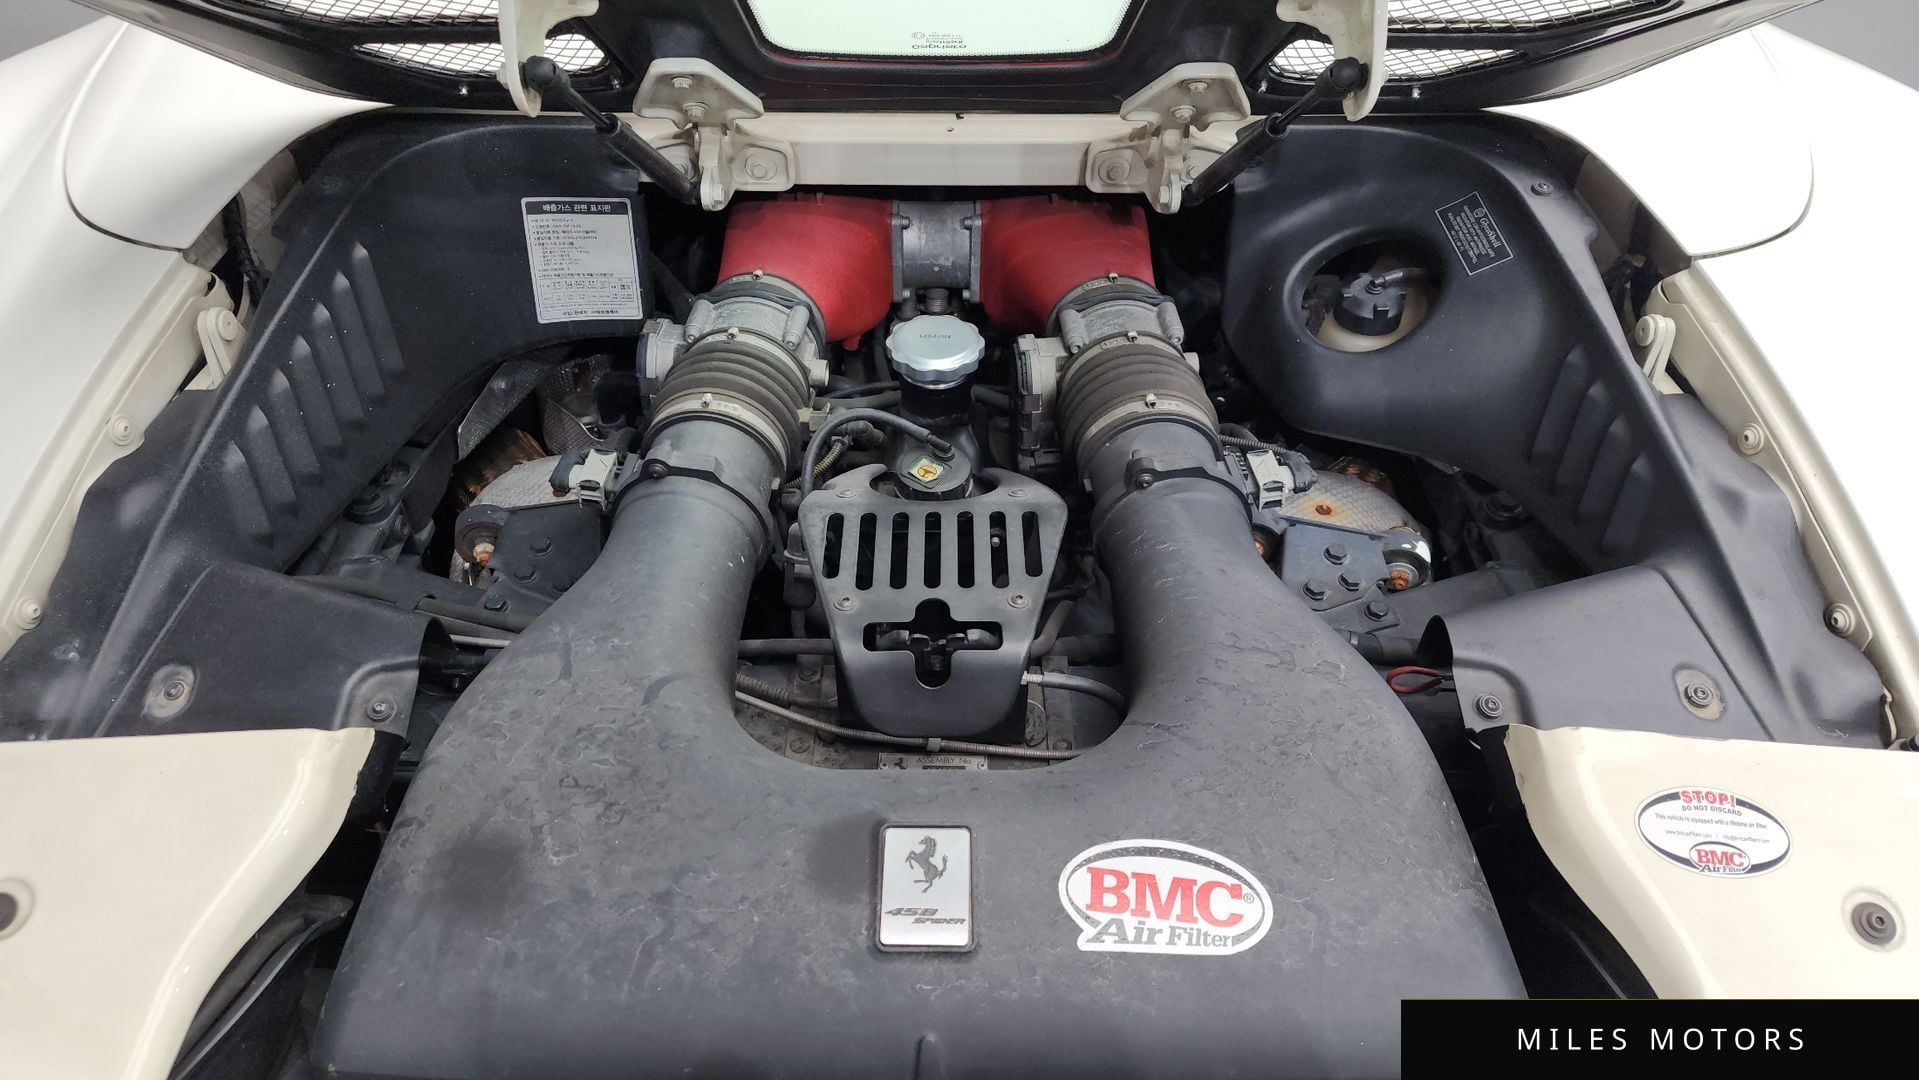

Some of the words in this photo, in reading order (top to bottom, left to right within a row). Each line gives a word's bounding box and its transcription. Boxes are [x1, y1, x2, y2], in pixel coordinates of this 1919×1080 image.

[542, 203, 572, 212] 배출가스
[573, 203, 588, 212] 관련
[590, 203, 612, 212] 표지판
[1680, 790, 1737, 807] STOP!
[1710, 805, 1742, 816] DISCARD
[1667, 814, 1684, 822] vehicle
[1690, 817, 1714, 826] equipped
[1729, 820, 1748, 828] lifetime
[1695, 848, 1745, 867] BMC
[1699, 864, 1722, 873] Air
[1722, 865, 1742, 873] Filter
[1085, 866, 1244, 928] BMC
[884, 907, 939, 916] 458
[912, 917, 967, 925] SPIDER
[1086, 917, 1164, 945] Air
[1165, 925, 1233, 947] Filter
